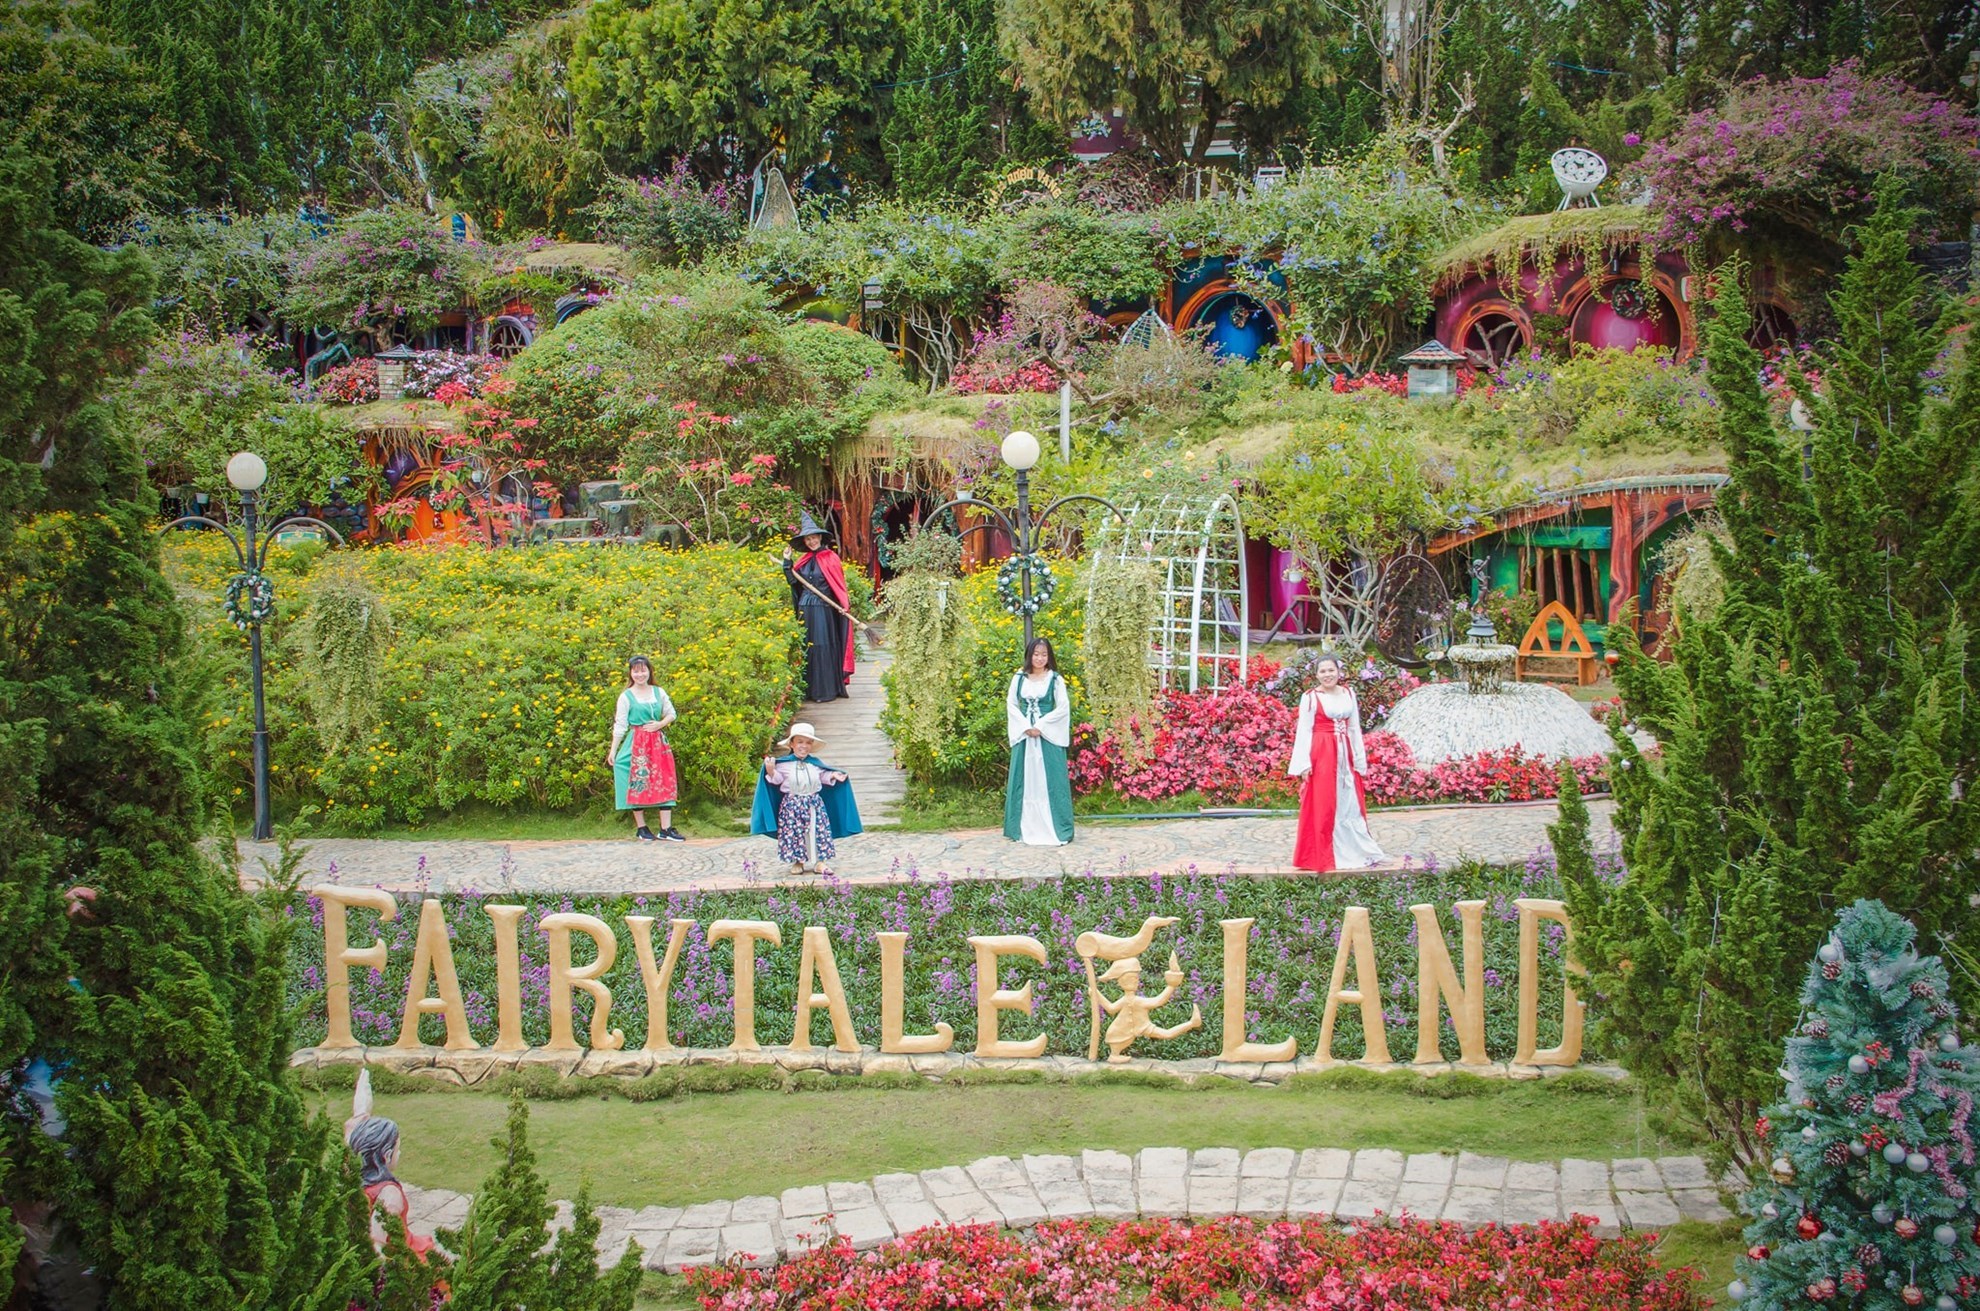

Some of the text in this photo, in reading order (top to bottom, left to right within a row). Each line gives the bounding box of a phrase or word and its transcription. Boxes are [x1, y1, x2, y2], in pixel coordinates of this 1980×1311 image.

[1037, 169, 1062, 199] VANG
[312, 883, 1587, 1066] FAIRYTALE LAND
